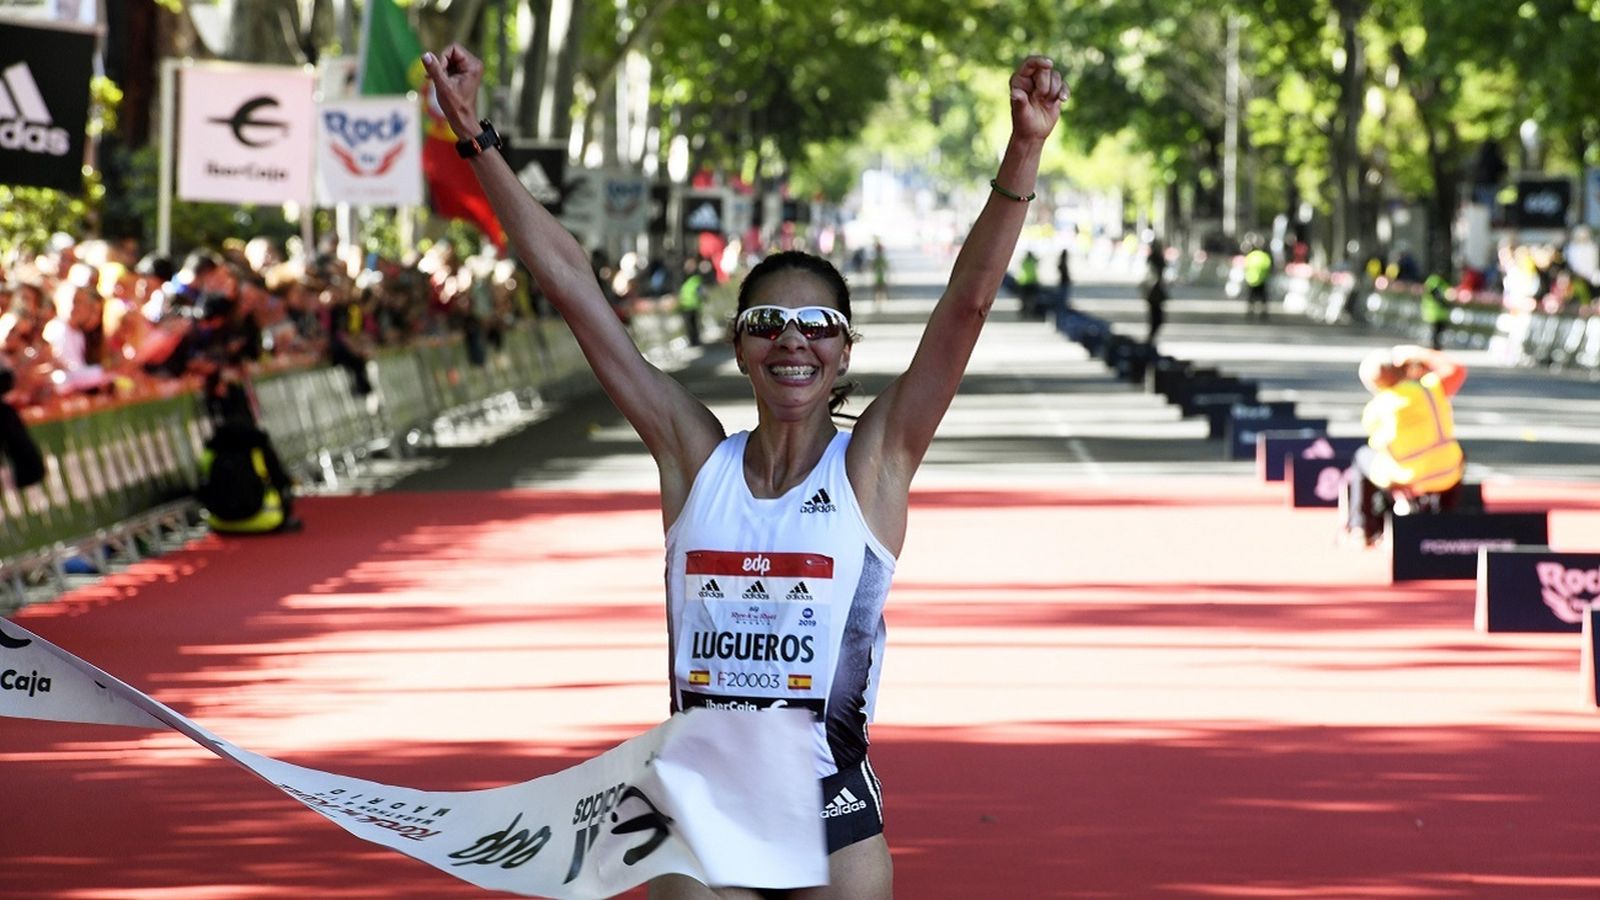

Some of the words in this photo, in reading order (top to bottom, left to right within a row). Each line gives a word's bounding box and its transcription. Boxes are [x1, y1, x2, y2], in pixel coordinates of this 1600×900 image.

[324, 109, 408, 148] Rock
[800, 502, 838, 514] adidas
[742, 554, 771, 576] edp
[1536, 561, 1600, 598] Roc
[742, 592, 770, 600] adidas
[786, 593, 813, 601] adidas
[798, 619, 817, 627] 2019
[692, 631, 814, 663] LUGUEROS
[0, 669, 52, 697] Caja
[717, 672, 780, 689] F20003
[329, 788, 452, 817] MADRID
[819, 799, 867, 819] adidas
